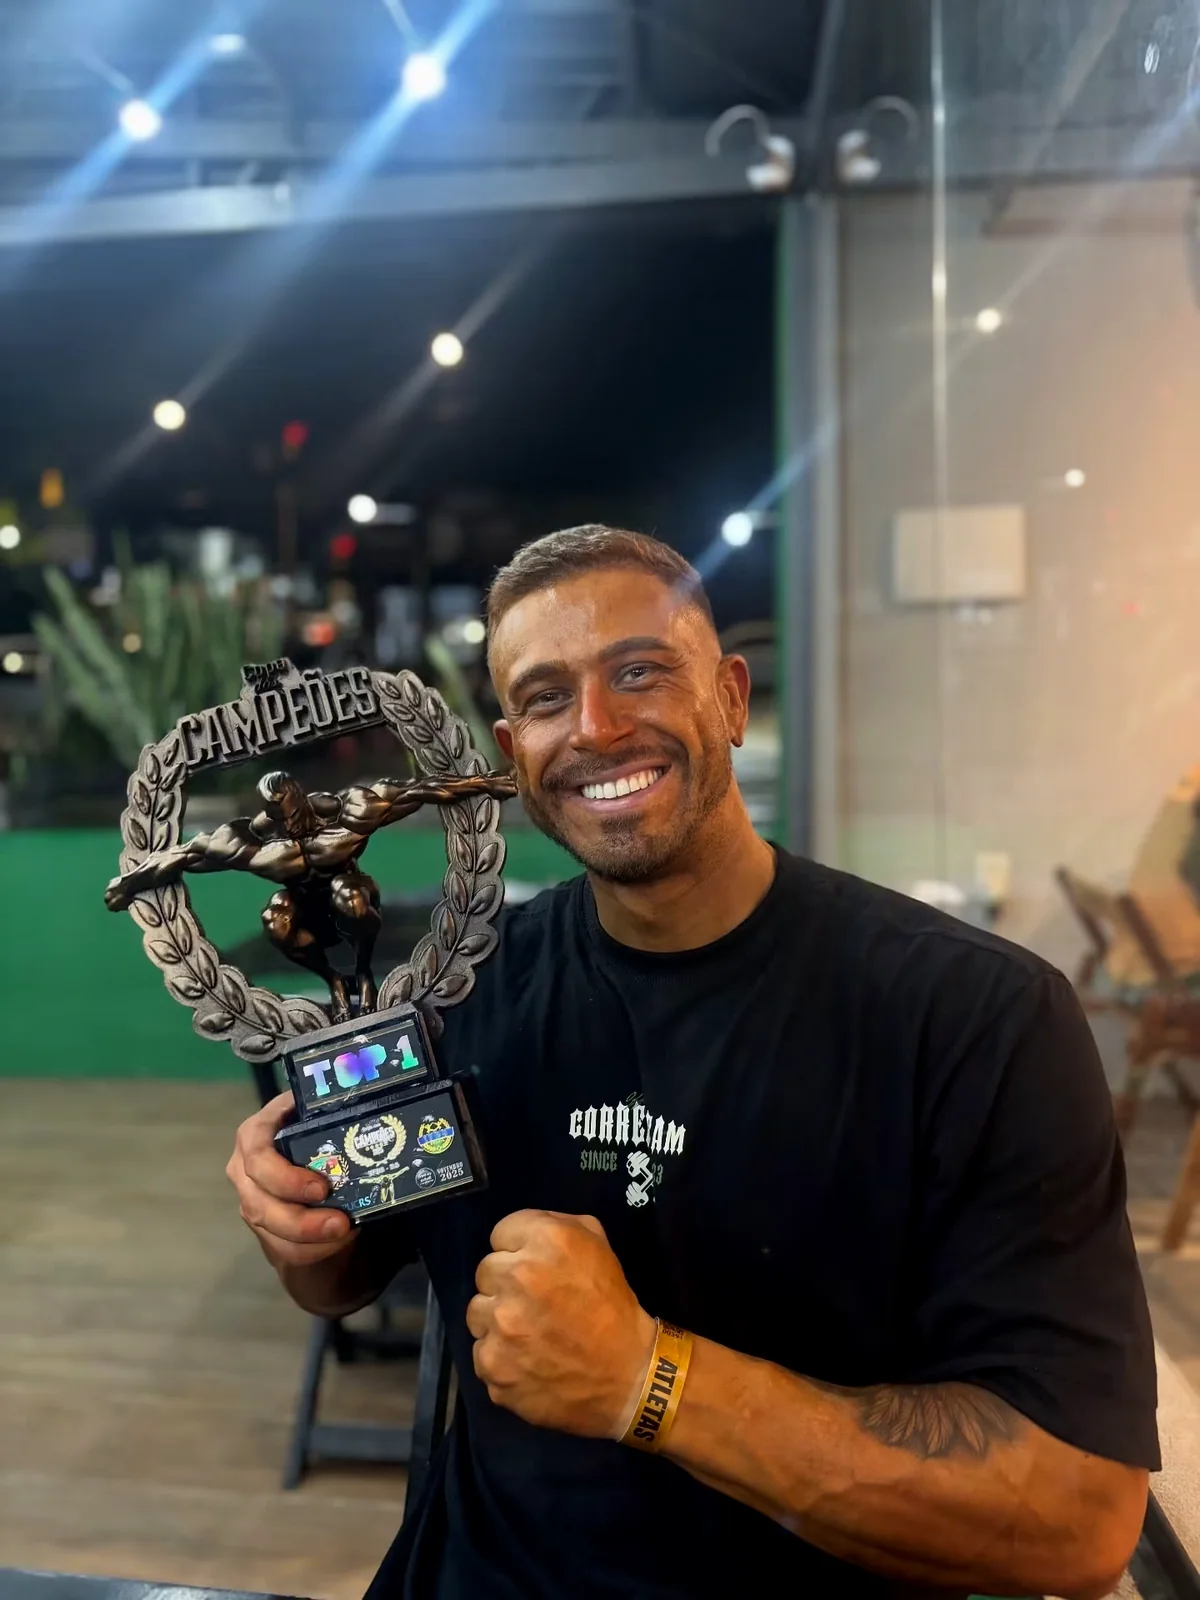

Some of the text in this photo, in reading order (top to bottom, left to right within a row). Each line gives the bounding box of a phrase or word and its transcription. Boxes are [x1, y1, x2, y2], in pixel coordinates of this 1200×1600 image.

[179, 667, 379, 766] CAMPEÕES
[302, 1034, 419, 1097] TOP 1
[440, 1167, 465, 1182] 2025
[580, 1148, 618, 1172] SINCE
[633, 1356, 679, 1442] ATLETAS
